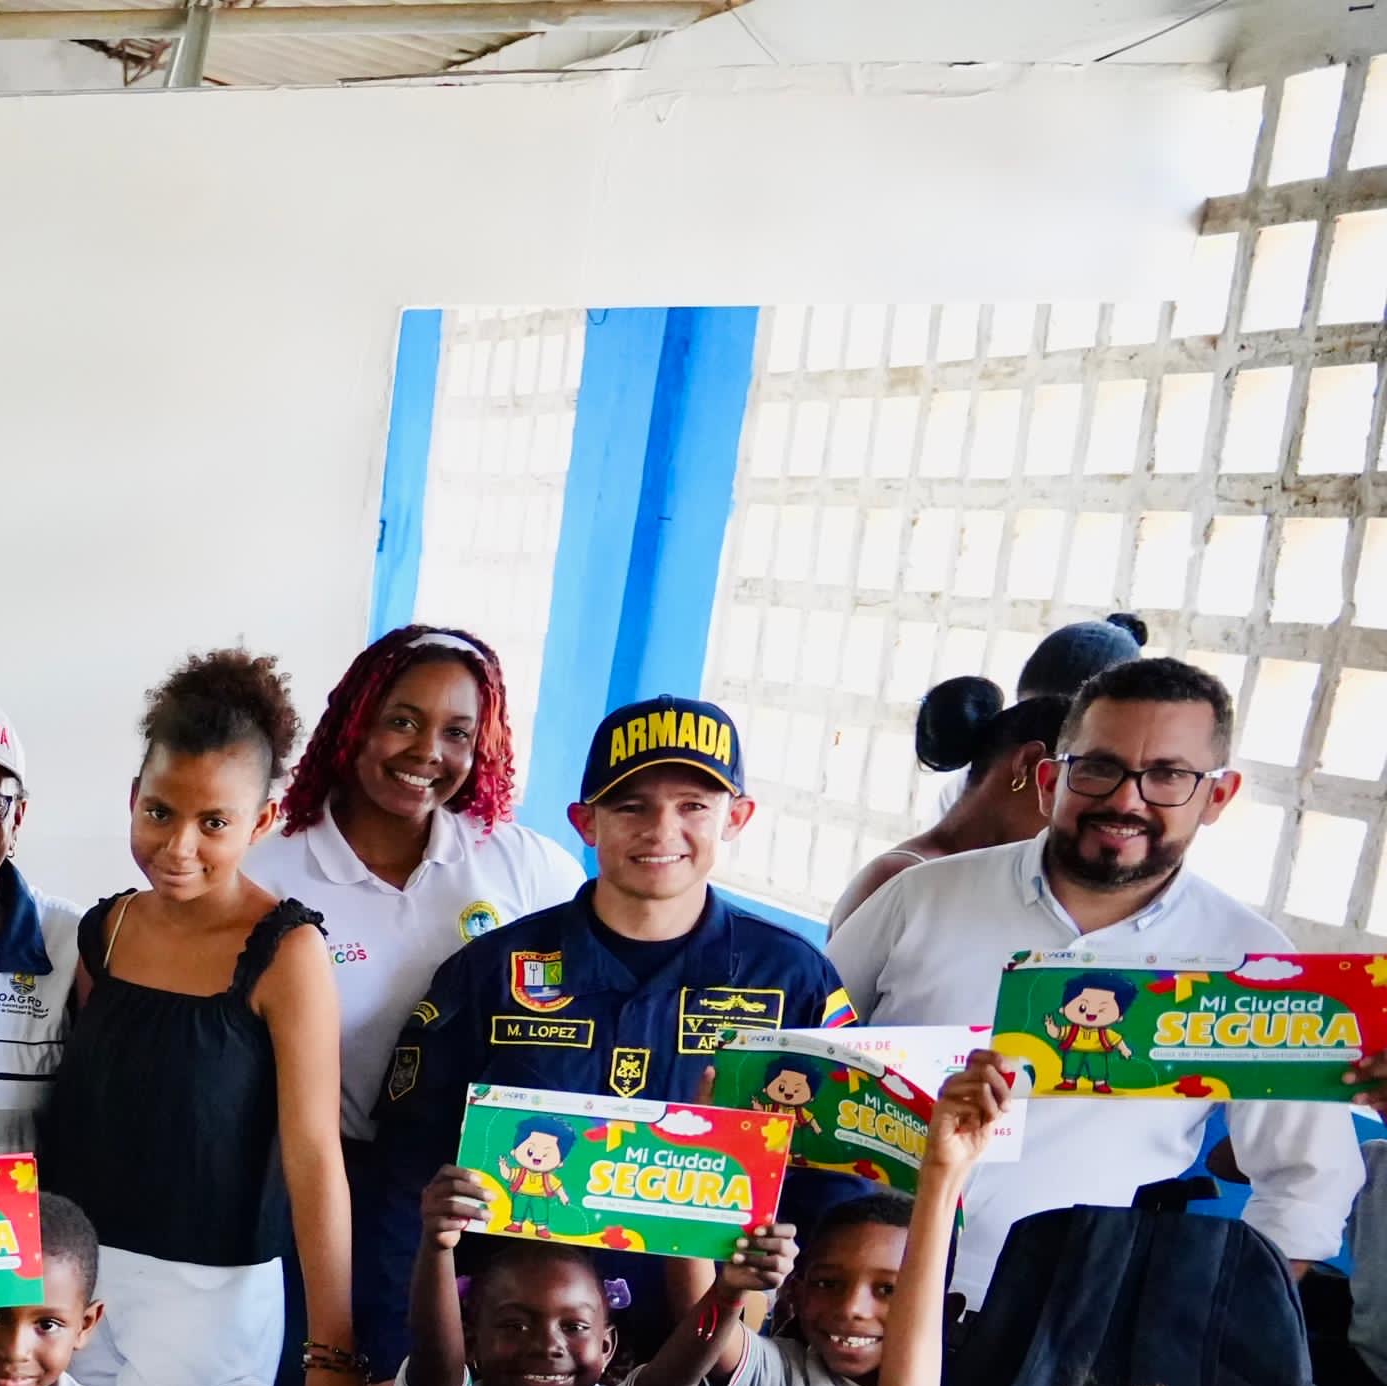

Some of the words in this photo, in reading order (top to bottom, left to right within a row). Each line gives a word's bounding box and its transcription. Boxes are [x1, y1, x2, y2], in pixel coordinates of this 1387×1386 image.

[609, 710, 733, 768] ARMADA
[331, 949, 368, 964] COS
[1199, 995, 1227, 1012] Mi
[1234, 995, 1324, 1013] Ciudad
[507, 1024, 523, 1037] M.
[529, 1025, 578, 1039] LOPEZ
[1153, 1011, 1363, 1048] SEGURA
[864, 1092, 881, 1110] Mi
[884, 1103, 929, 1137] Ciudad
[624, 1146, 648, 1167] Mi
[653, 1149, 727, 1172] Ciudad
[586, 1160, 753, 1211] SEGURA
